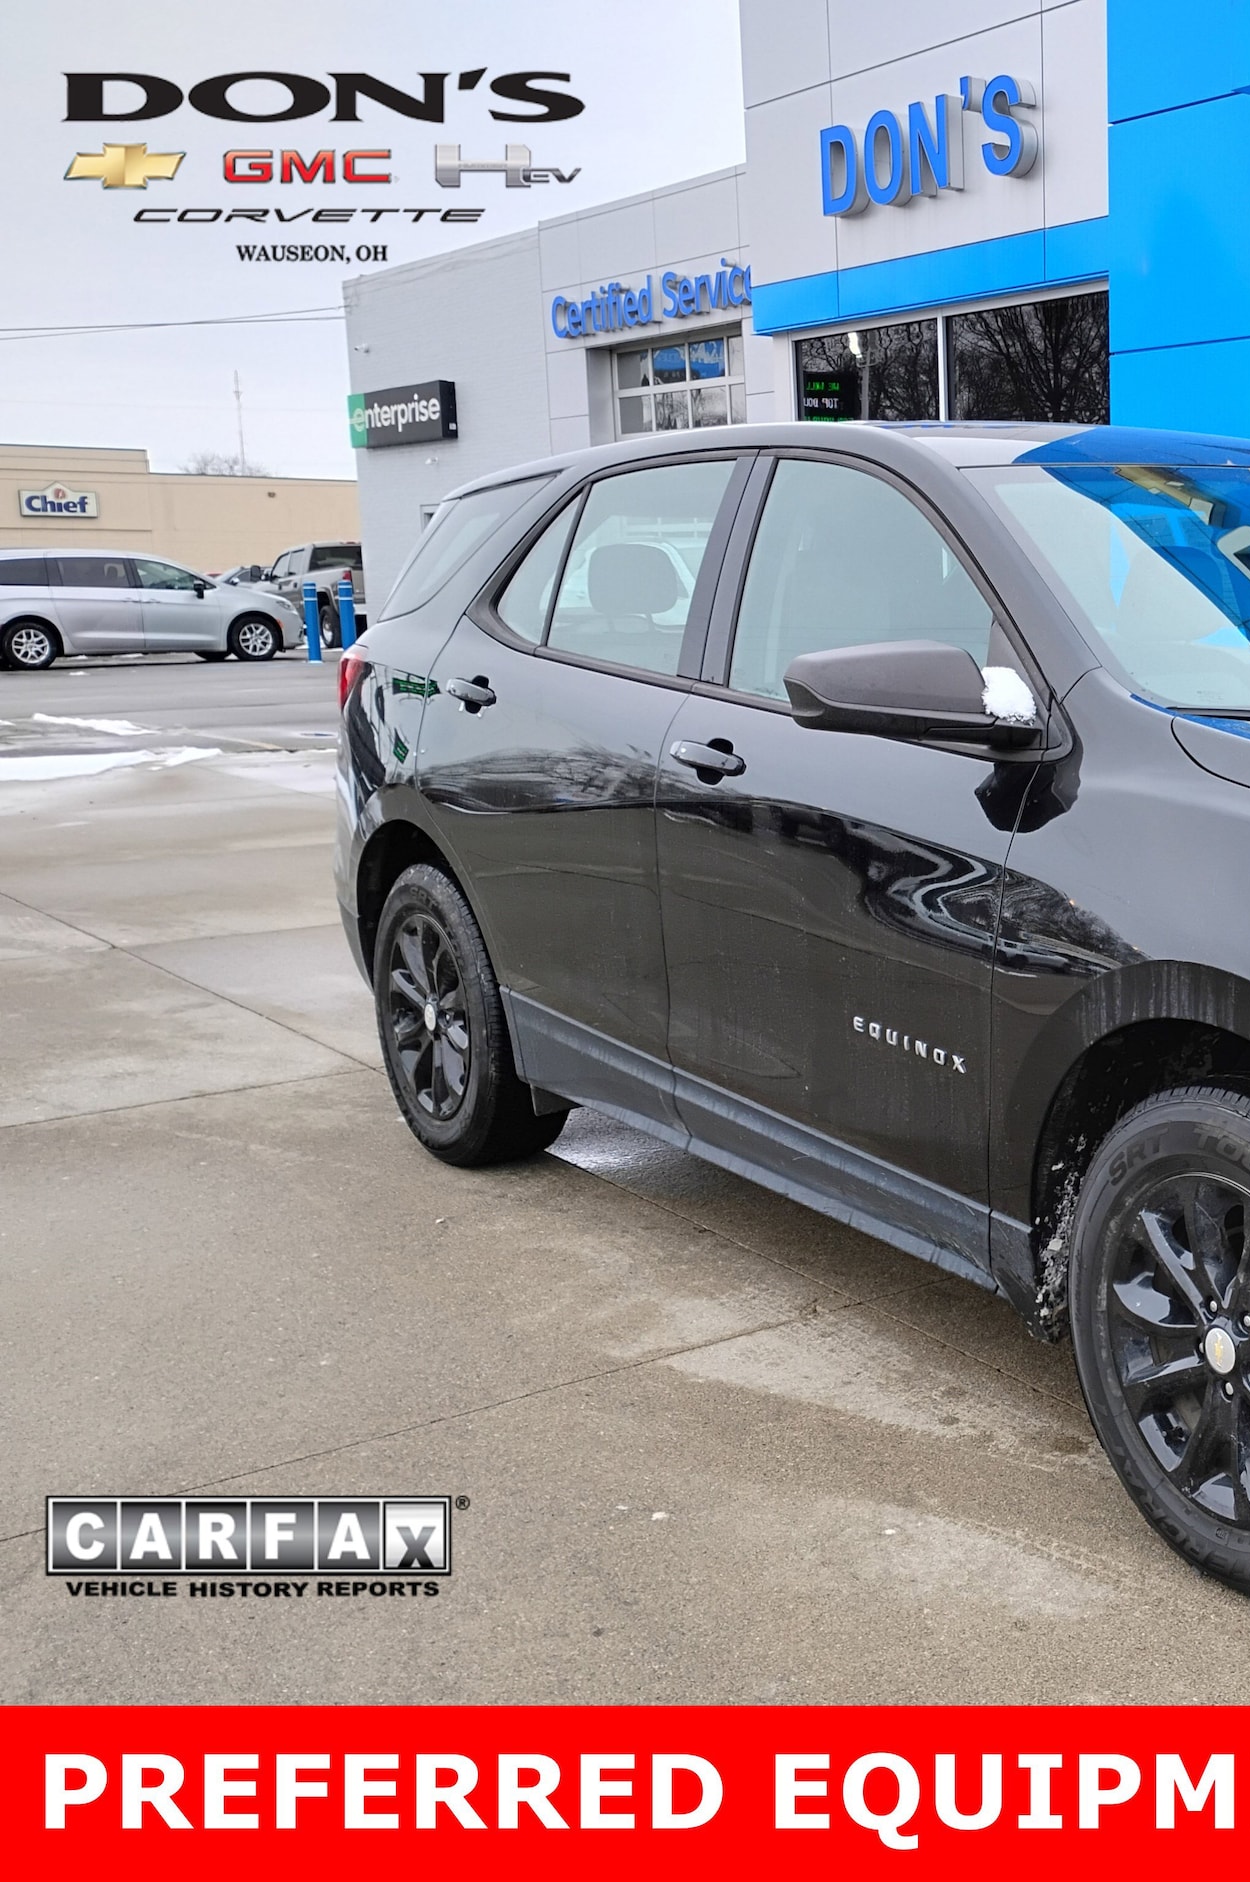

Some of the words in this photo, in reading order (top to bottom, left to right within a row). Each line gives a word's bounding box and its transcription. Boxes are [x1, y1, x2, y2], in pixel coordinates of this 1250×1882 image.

[819, 74, 1030, 217] DON'S
[551, 275, 653, 338] Certified
[349, 393, 440, 433] enterprise
[24, 494, 88, 513] Chief
[852, 1016, 967, 1074] EQUINOX
